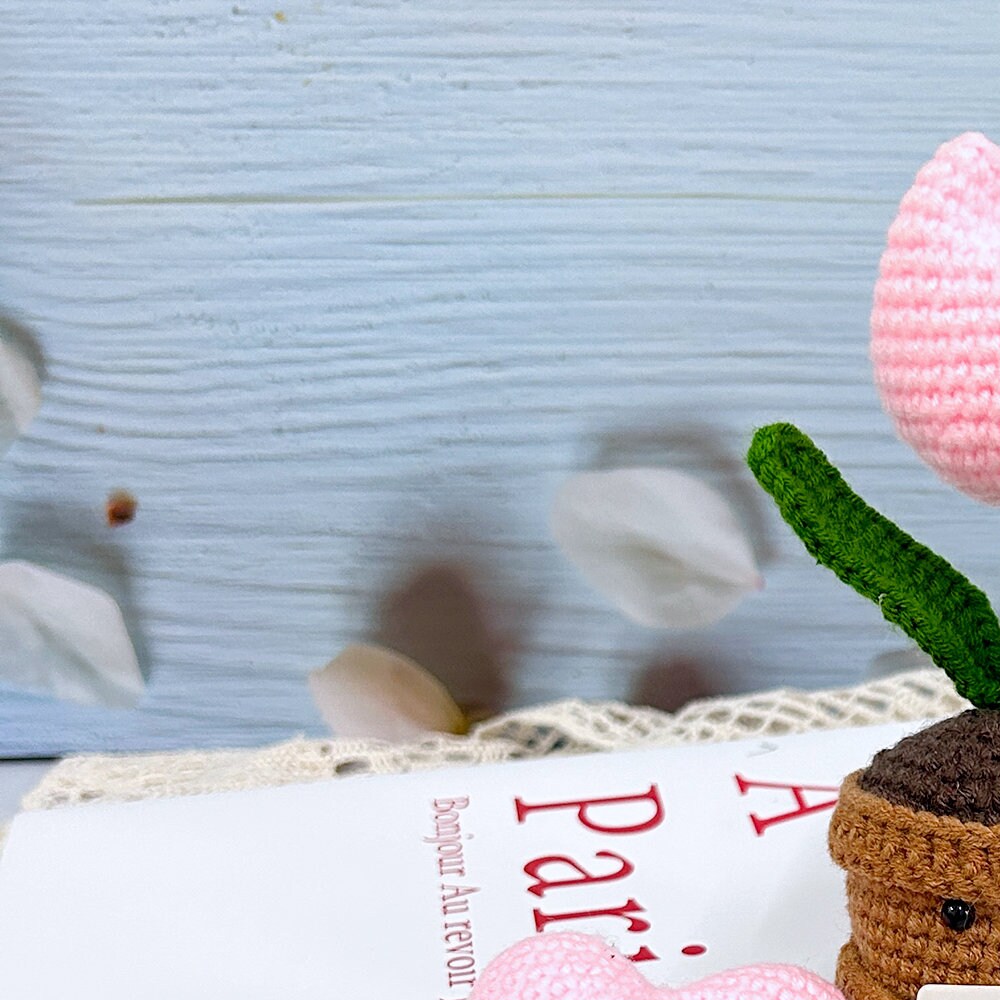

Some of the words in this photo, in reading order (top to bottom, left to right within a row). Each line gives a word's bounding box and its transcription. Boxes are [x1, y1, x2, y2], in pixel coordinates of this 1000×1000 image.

[424, 797, 472, 876] Bonjour
[733, 773, 839, 836] A
[440, 883, 480, 916] Au
[443, 919, 477, 988] revoir
